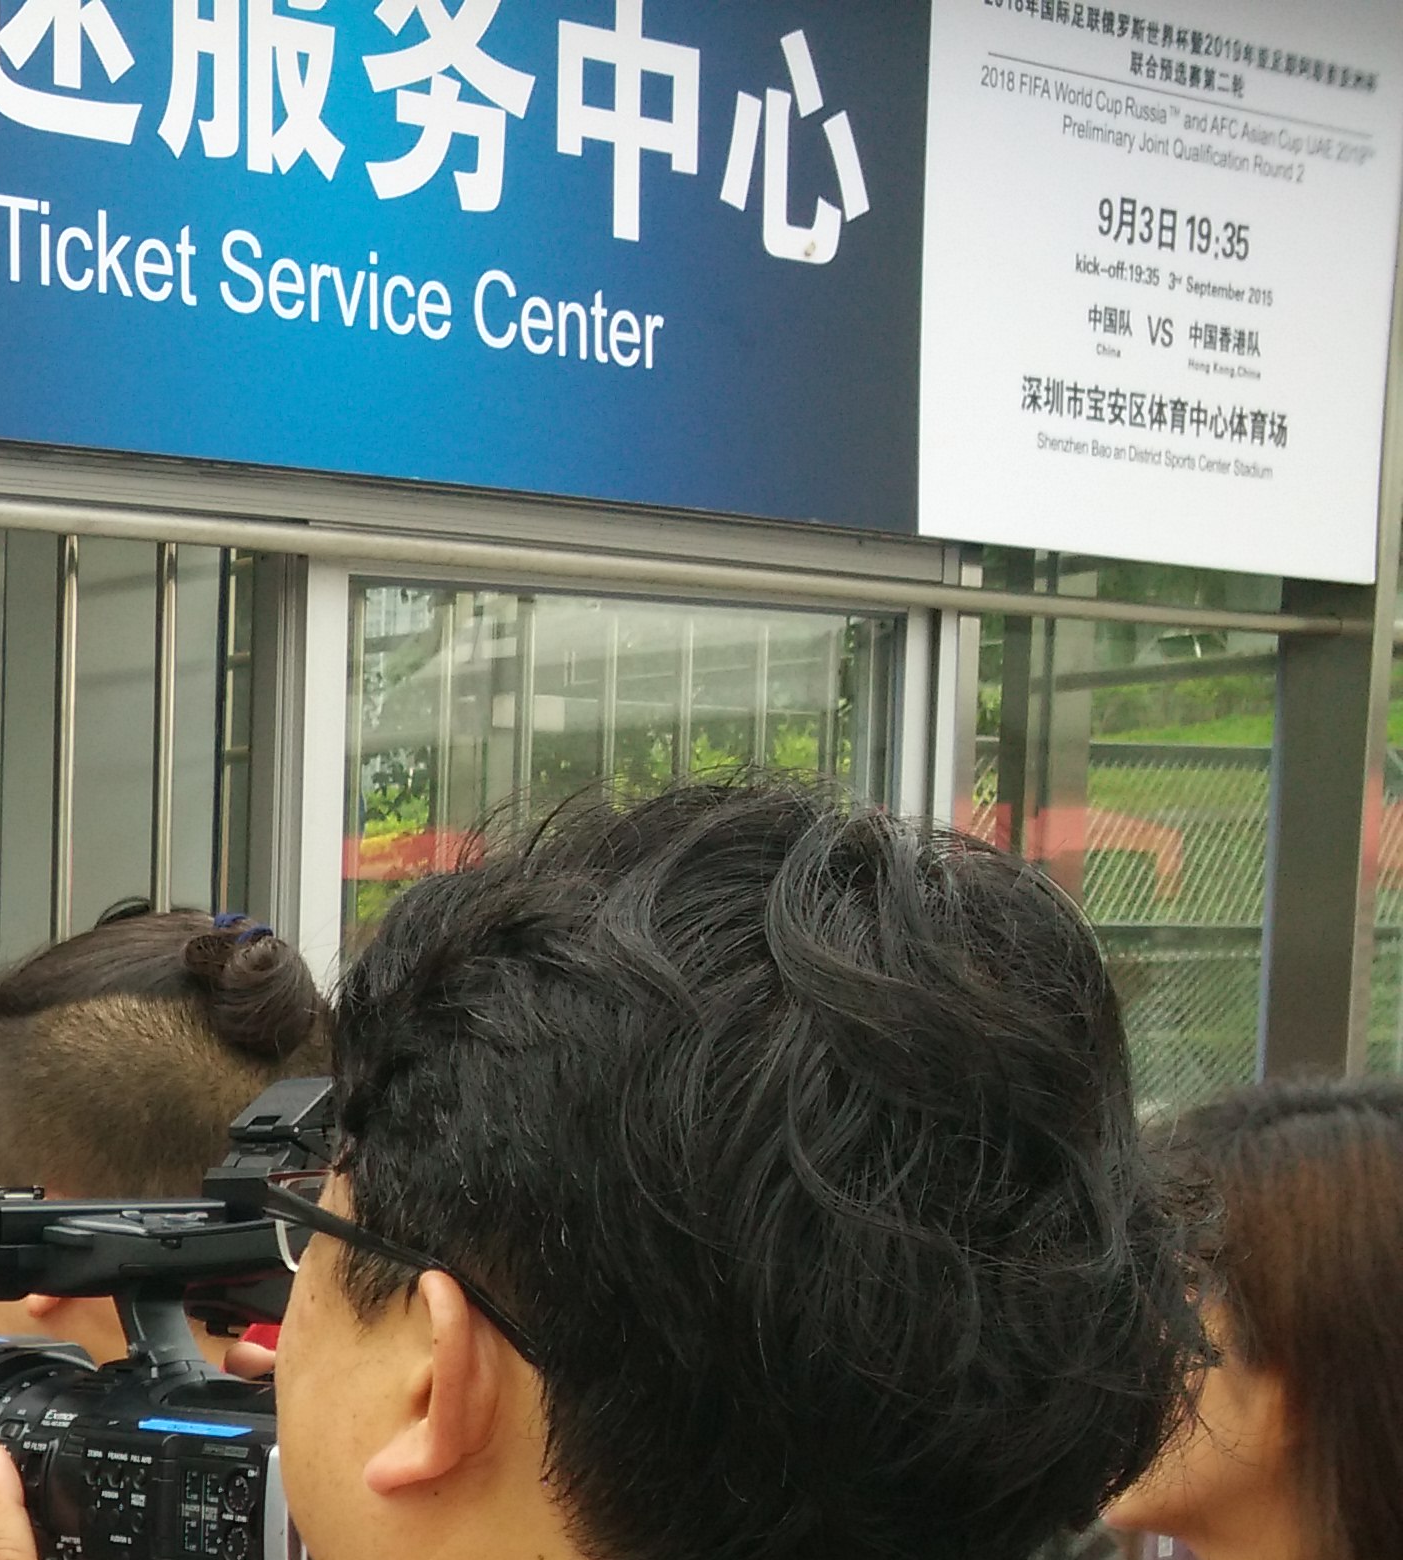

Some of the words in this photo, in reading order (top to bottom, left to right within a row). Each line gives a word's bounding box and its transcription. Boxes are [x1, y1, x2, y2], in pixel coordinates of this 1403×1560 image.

[981, 65, 1015, 93] 2018
[1019, 73, 1051, 100] FIFA
[1054, 81, 1093, 109] World
[1095, 90, 1123, 119] Cup
[1062, 114, 1136, 154] Preliminary
[1138, 132, 1171, 157] Joint
[1172, 138, 1251, 173] Qualification
[1295, 163, 1307, 184] 2
[1097, 196, 1178, 253] 9月3日
[1186, 214, 1251, 262] 19:35
[219, 229, 452, 341] Service
[473, 268, 665, 370] Center
[1186, 275, 1246, 303] September
[1087, 303, 1133, 338] 中国队
[1147, 314, 1175, 348] VS
[1188, 319, 1262, 359] 中国香港队
[1020, 374, 1288, 450] 深圳市宝安区体育中心体育场
[1037, 431, 1090, 456] Shenzhen
